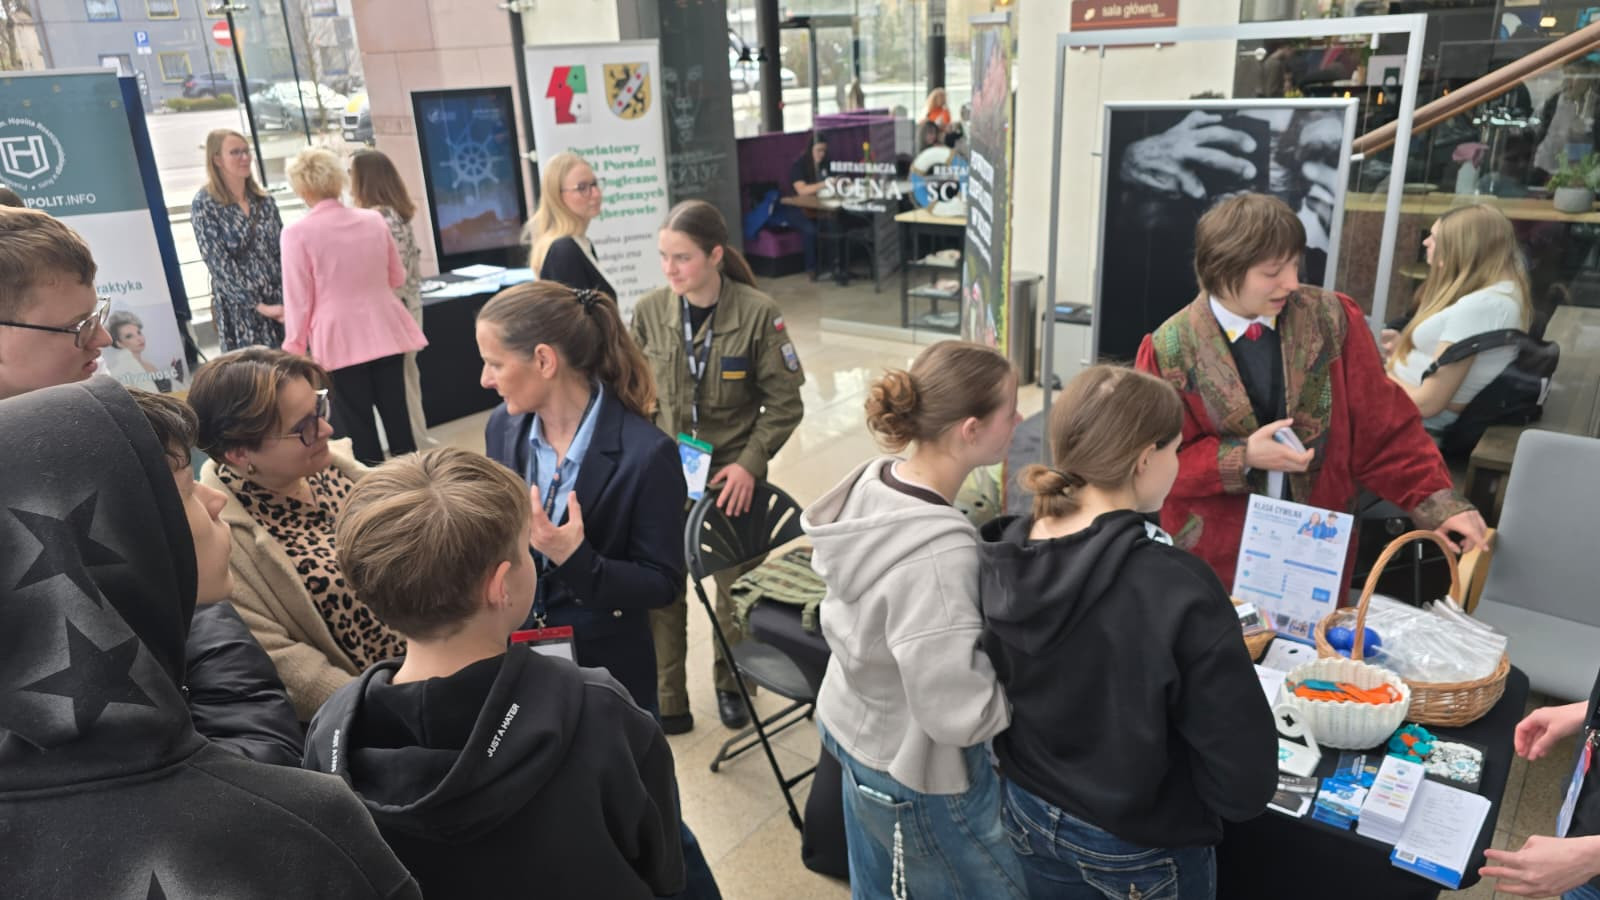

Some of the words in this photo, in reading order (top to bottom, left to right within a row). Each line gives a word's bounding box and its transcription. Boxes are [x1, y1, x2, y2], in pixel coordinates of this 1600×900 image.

[1102, 4, 1121, 17] sala
[824, 176, 903, 201] SCENA
[24, 193, 96, 208] IPOLIT.INFO
[96, 280, 143, 295] raktyka
[487, 734, 501, 757] JUST
[500, 703, 520, 730] HATER
